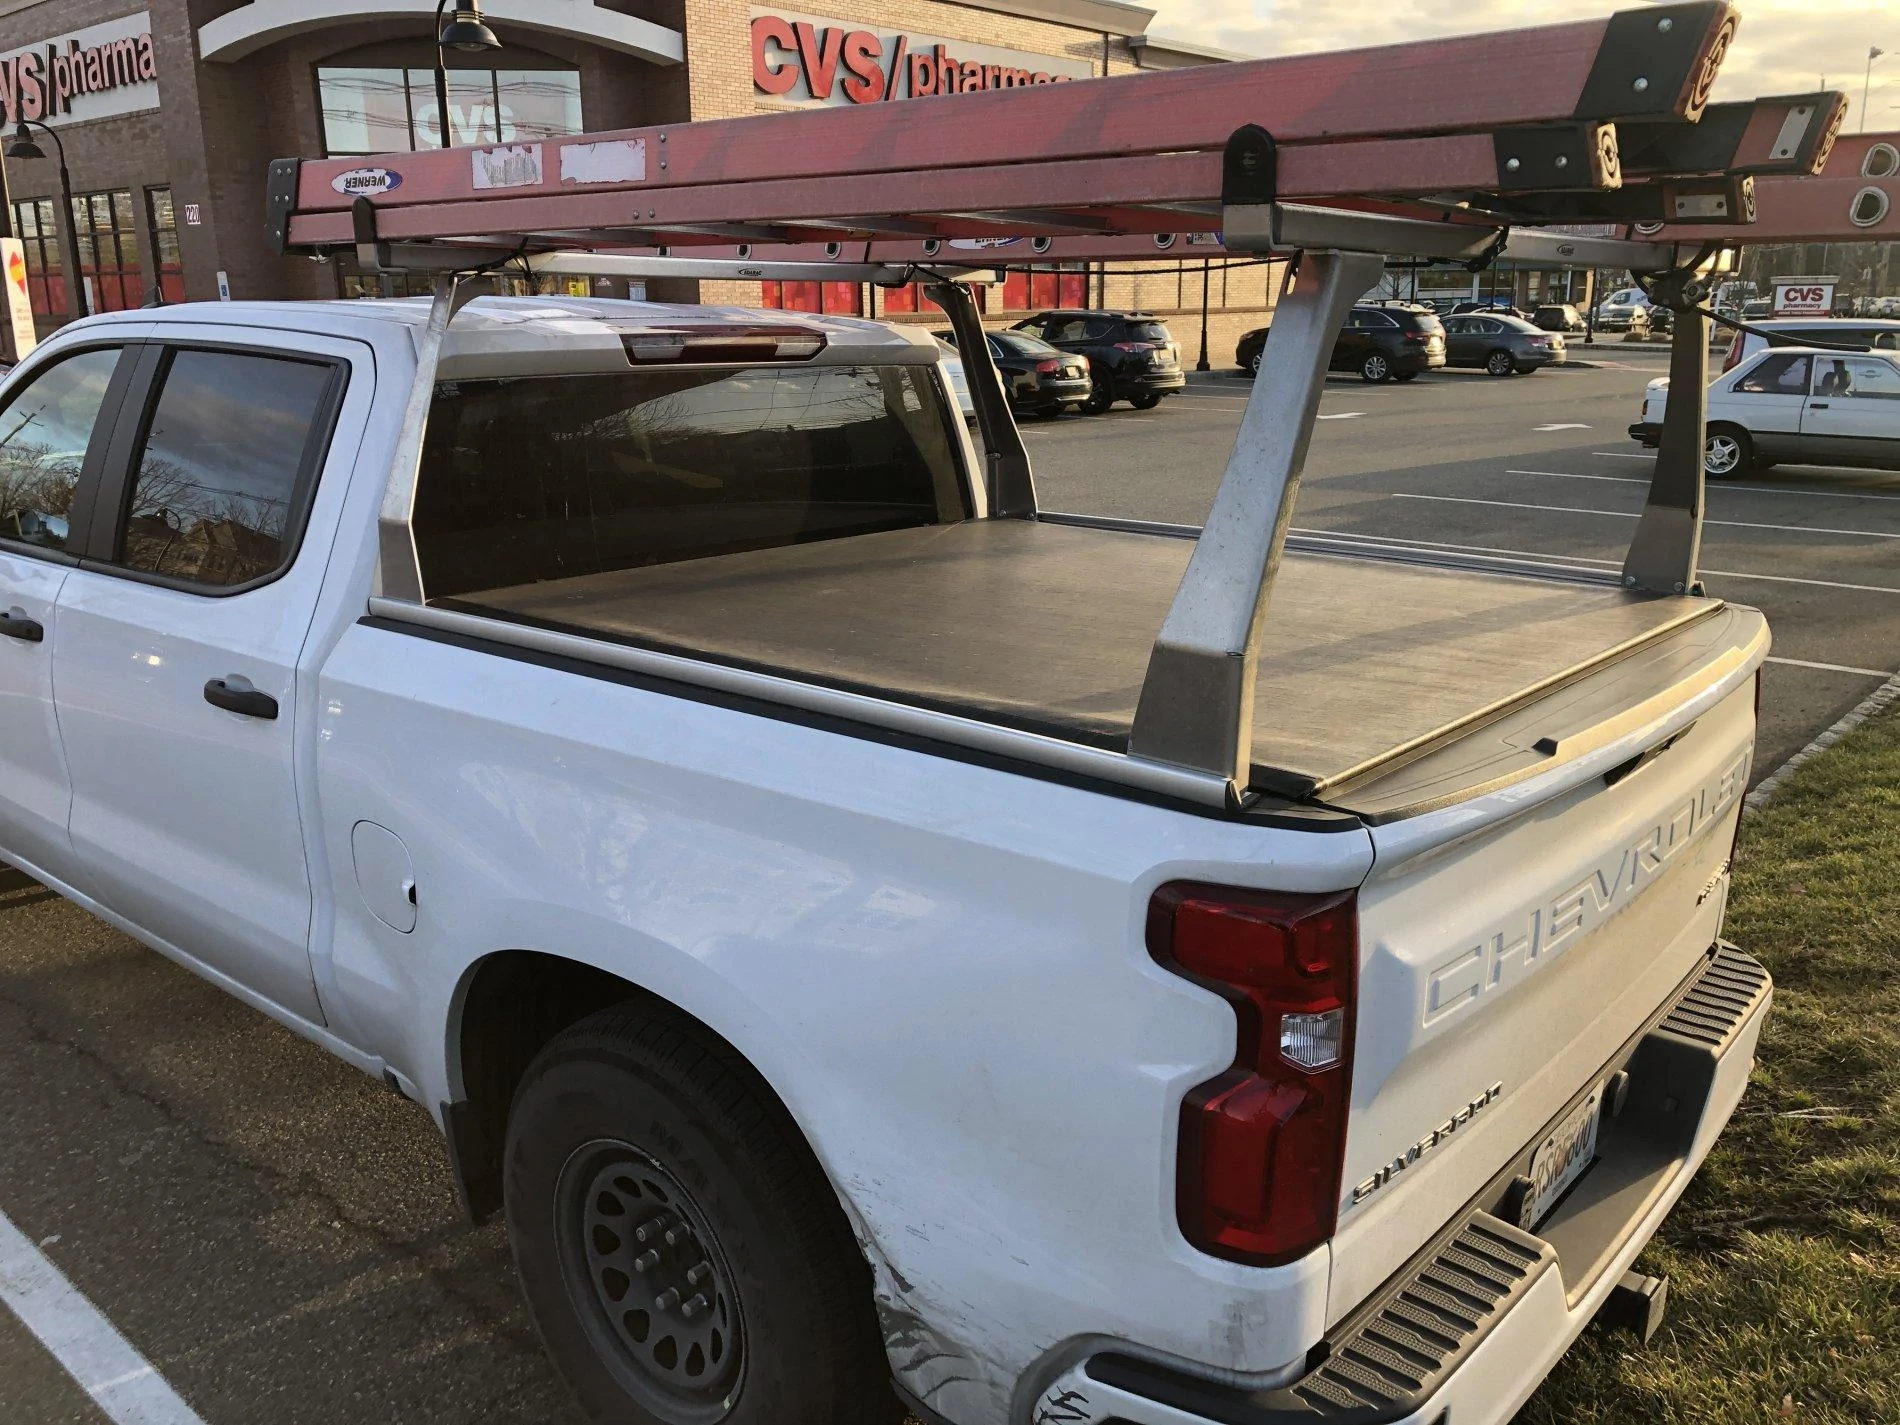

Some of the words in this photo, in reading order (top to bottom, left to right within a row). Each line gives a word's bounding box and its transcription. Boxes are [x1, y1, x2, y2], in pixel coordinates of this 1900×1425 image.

[0, 33, 157, 125] VS/pharma
[415, 103, 517, 144] CVS
[344, 174, 386, 189] WERNER
[1783, 302, 1822, 310] pharmacy
[1784, 287, 1825, 302] CVS
[1422, 739, 1754, 1029] CHEVROLET
[1351, 1080, 1503, 1205] SILVERADO
